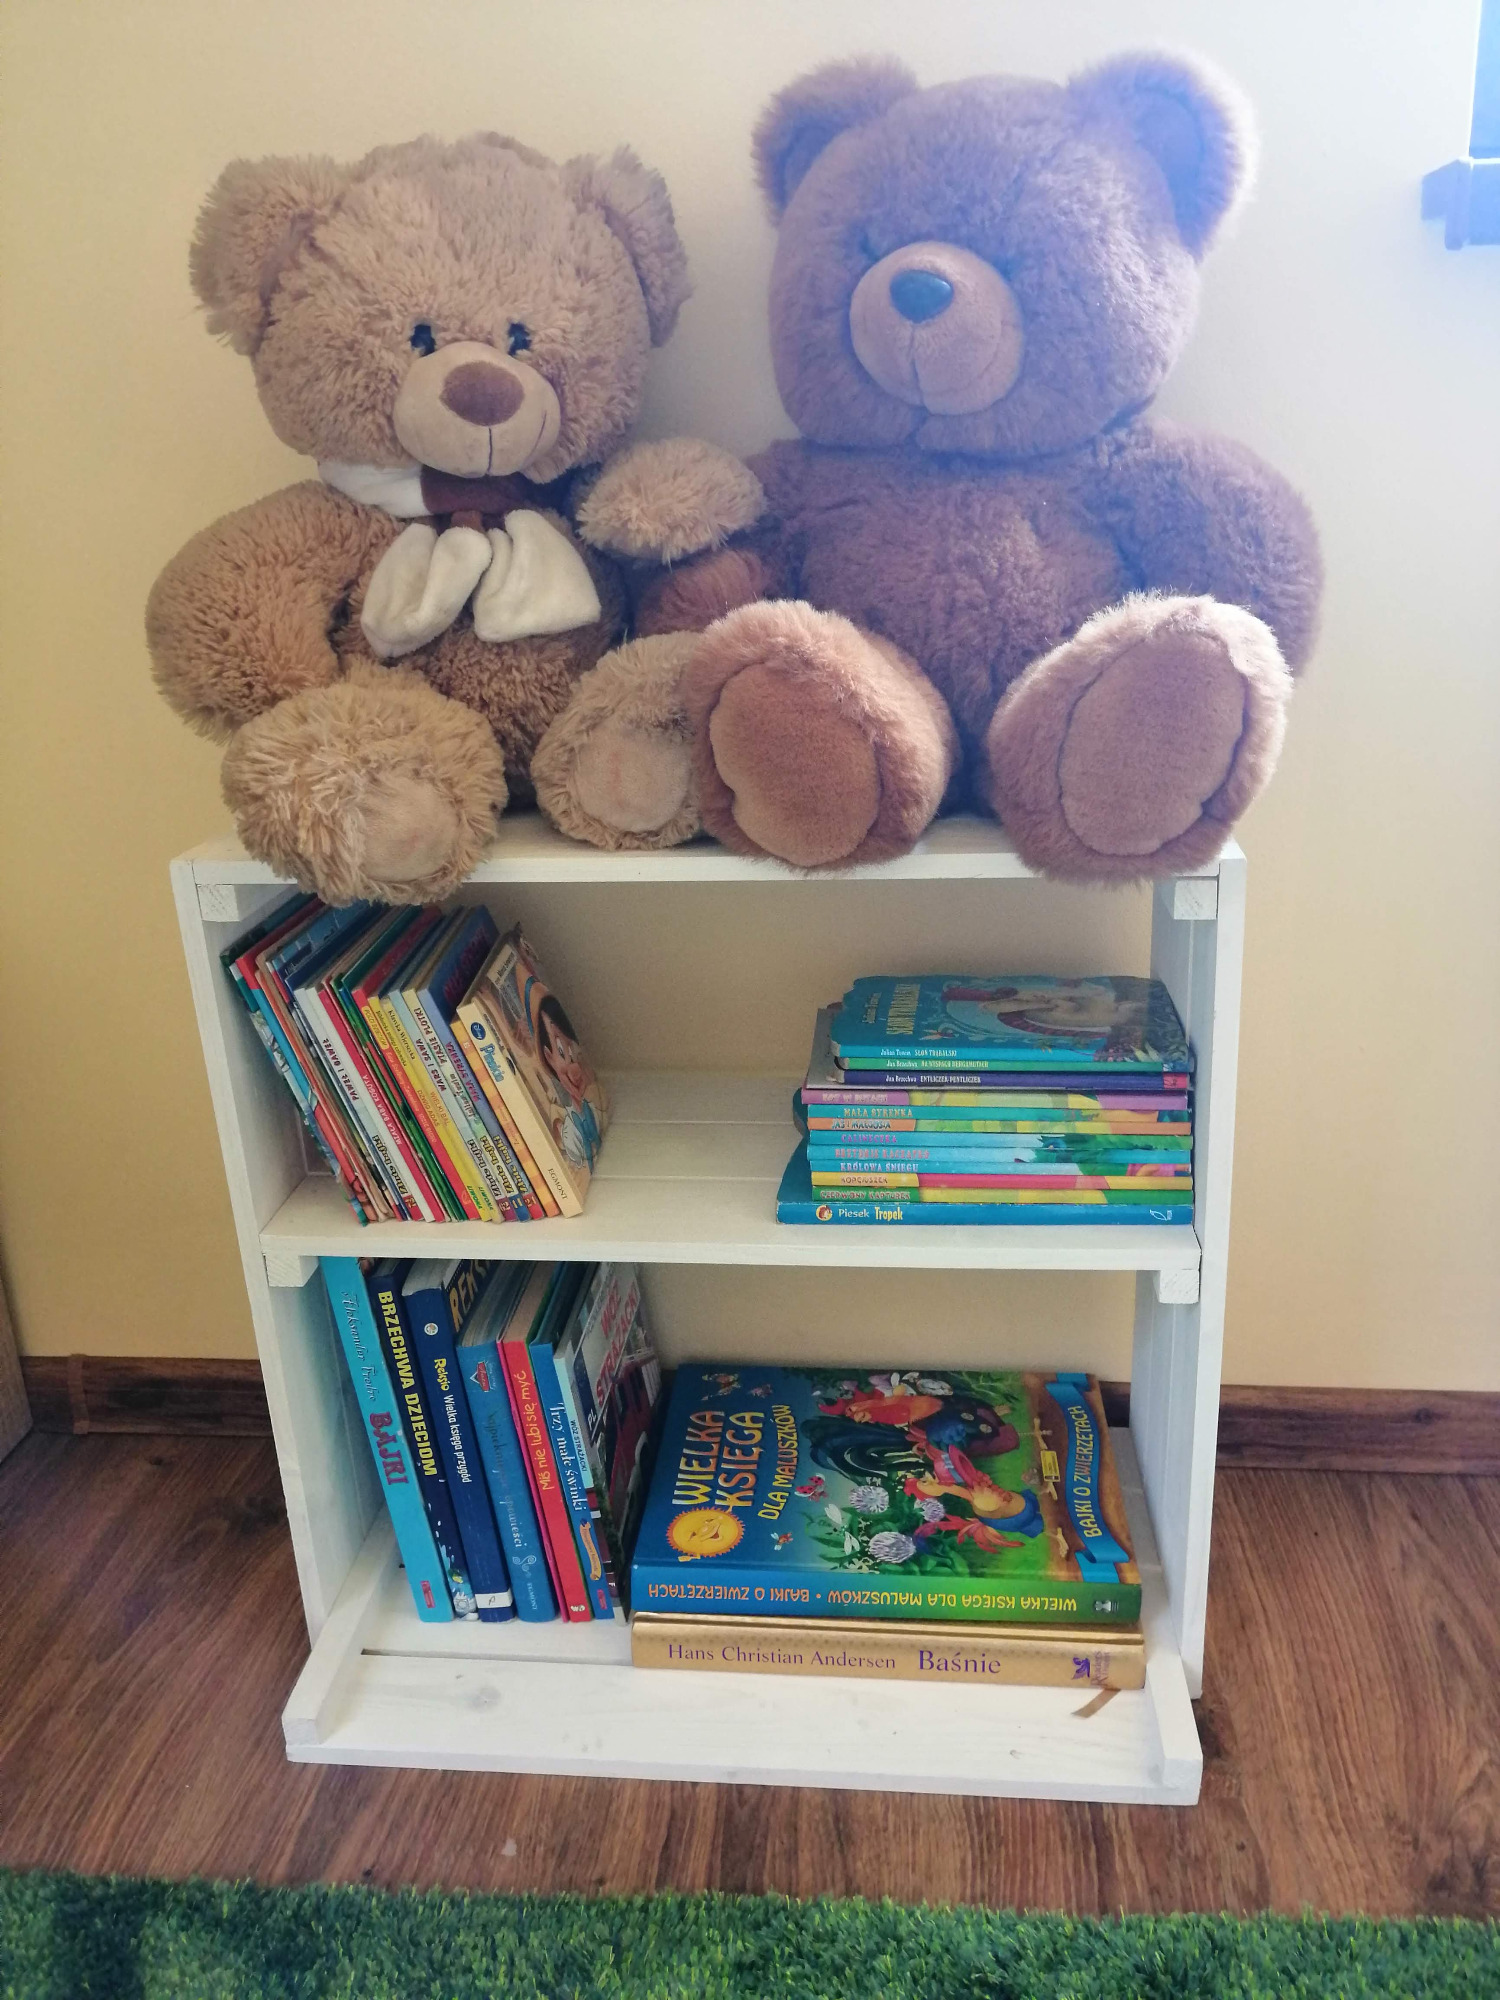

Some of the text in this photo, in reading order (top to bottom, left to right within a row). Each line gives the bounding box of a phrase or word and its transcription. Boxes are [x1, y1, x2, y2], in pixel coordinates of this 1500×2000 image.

[321, 1037, 341, 1067] GAWEŁ
[414, 1037, 431, 1062] SAWA
[428, 1036, 447, 1064] PTASIE
[431, 1068, 447, 1091] WARS
[444, 1040, 481, 1102] MAŁA SYRENKA
[886, 1075, 895, 1083] Jan
[340, 1073, 359, 1101] PAWEŁ
[429, 1091, 444, 1113] WIELKI
[361, 1073, 403, 1146] MIAŁA BABA KOGUTA
[844, 1108, 913, 1117] MAŁA SYRENKA
[371, 1133, 394, 1165] bajki
[841, 1134, 897, 1143] CALINECZKA
[840, 1162, 919, 1172] KRÓLOWA ŚNIEGU
[546, 1167, 568, 1201] EGMONT
[820, 1191, 911, 1199] CZERWONY KAPTUREK
[838, 1206, 903, 1221] Piesek Tropek
[378, 1290, 438, 1477] BRZECHWA DZIECIOM
[434, 1358, 473, 1483] Reksio Wielka księga przygód
[514, 1370, 555, 1491] Miś nie lubi się myć
[369, 1411, 409, 1486] BAJKI
[549, 1401, 588, 1512] Trzy małe świnki
[570, 1419, 587, 1472] WÓZ STRAŻACKI
[672, 1410, 765, 1507] WIELKA KSIĘGA
[757, 1404, 798, 1520] DLA MALUSZKÓW
[1067, 1405, 1103, 1538] BAJKI O ZWIERZĘTACH
[526, 1582, 537, 1610] EGMONT
[648, 1583, 1077, 1611] WIELKA KSIĘGA DLA MALUSZKÓW BAJKI O ZWIERZĘTACH
[668, 1644, 1001, 1674] Hans Christian Andersen Baśnie
